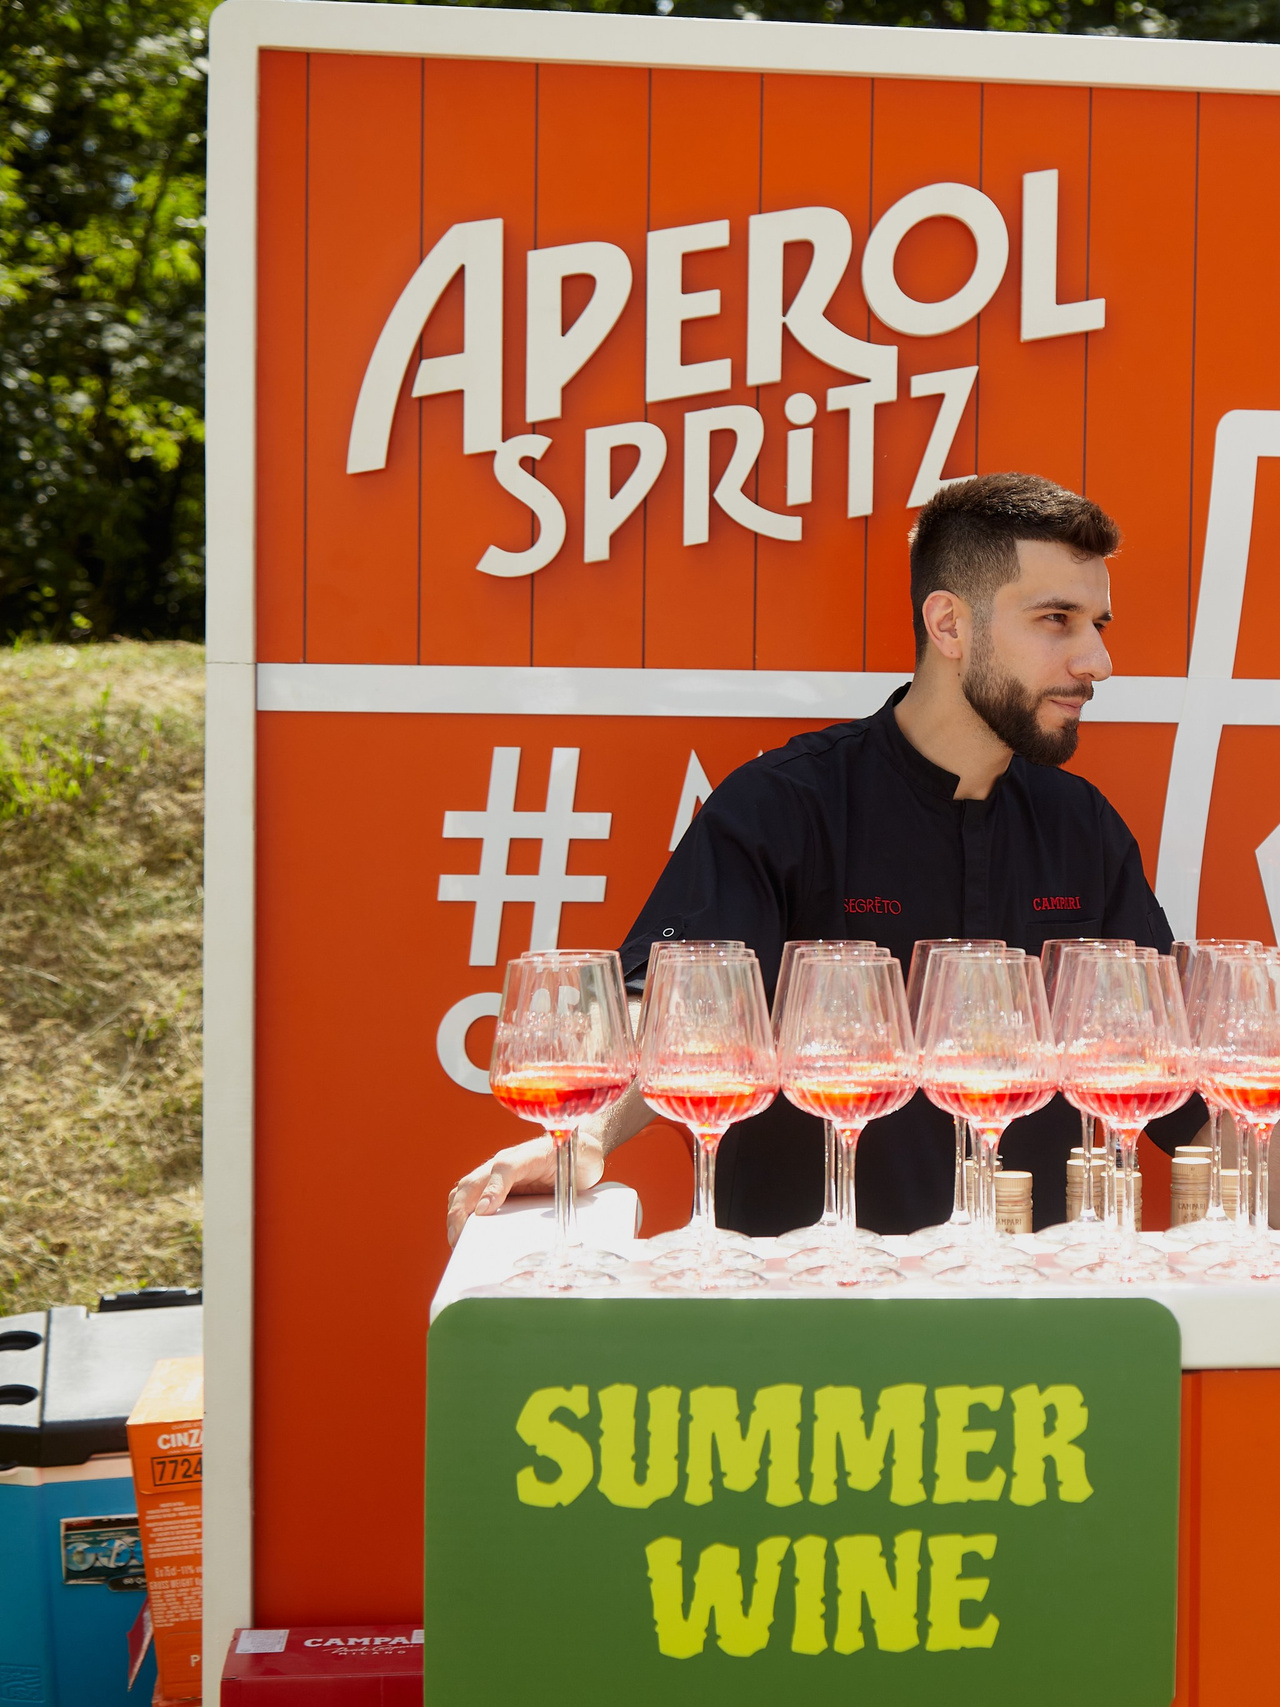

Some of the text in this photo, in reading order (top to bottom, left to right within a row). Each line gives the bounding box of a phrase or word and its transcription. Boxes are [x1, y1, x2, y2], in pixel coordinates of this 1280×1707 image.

[346, 168, 1107, 475] APEROL
[1033, 896, 1081, 911] CAMPARI
[994, 1218, 1022, 1226] AMPARI
[157, 1429, 203, 1451] CINZ
[515, 1382, 1094, 1509] SUMMER
[644, 1529, 1001, 1660] WINE
[303, 1636, 412, 1648] CAMPA
